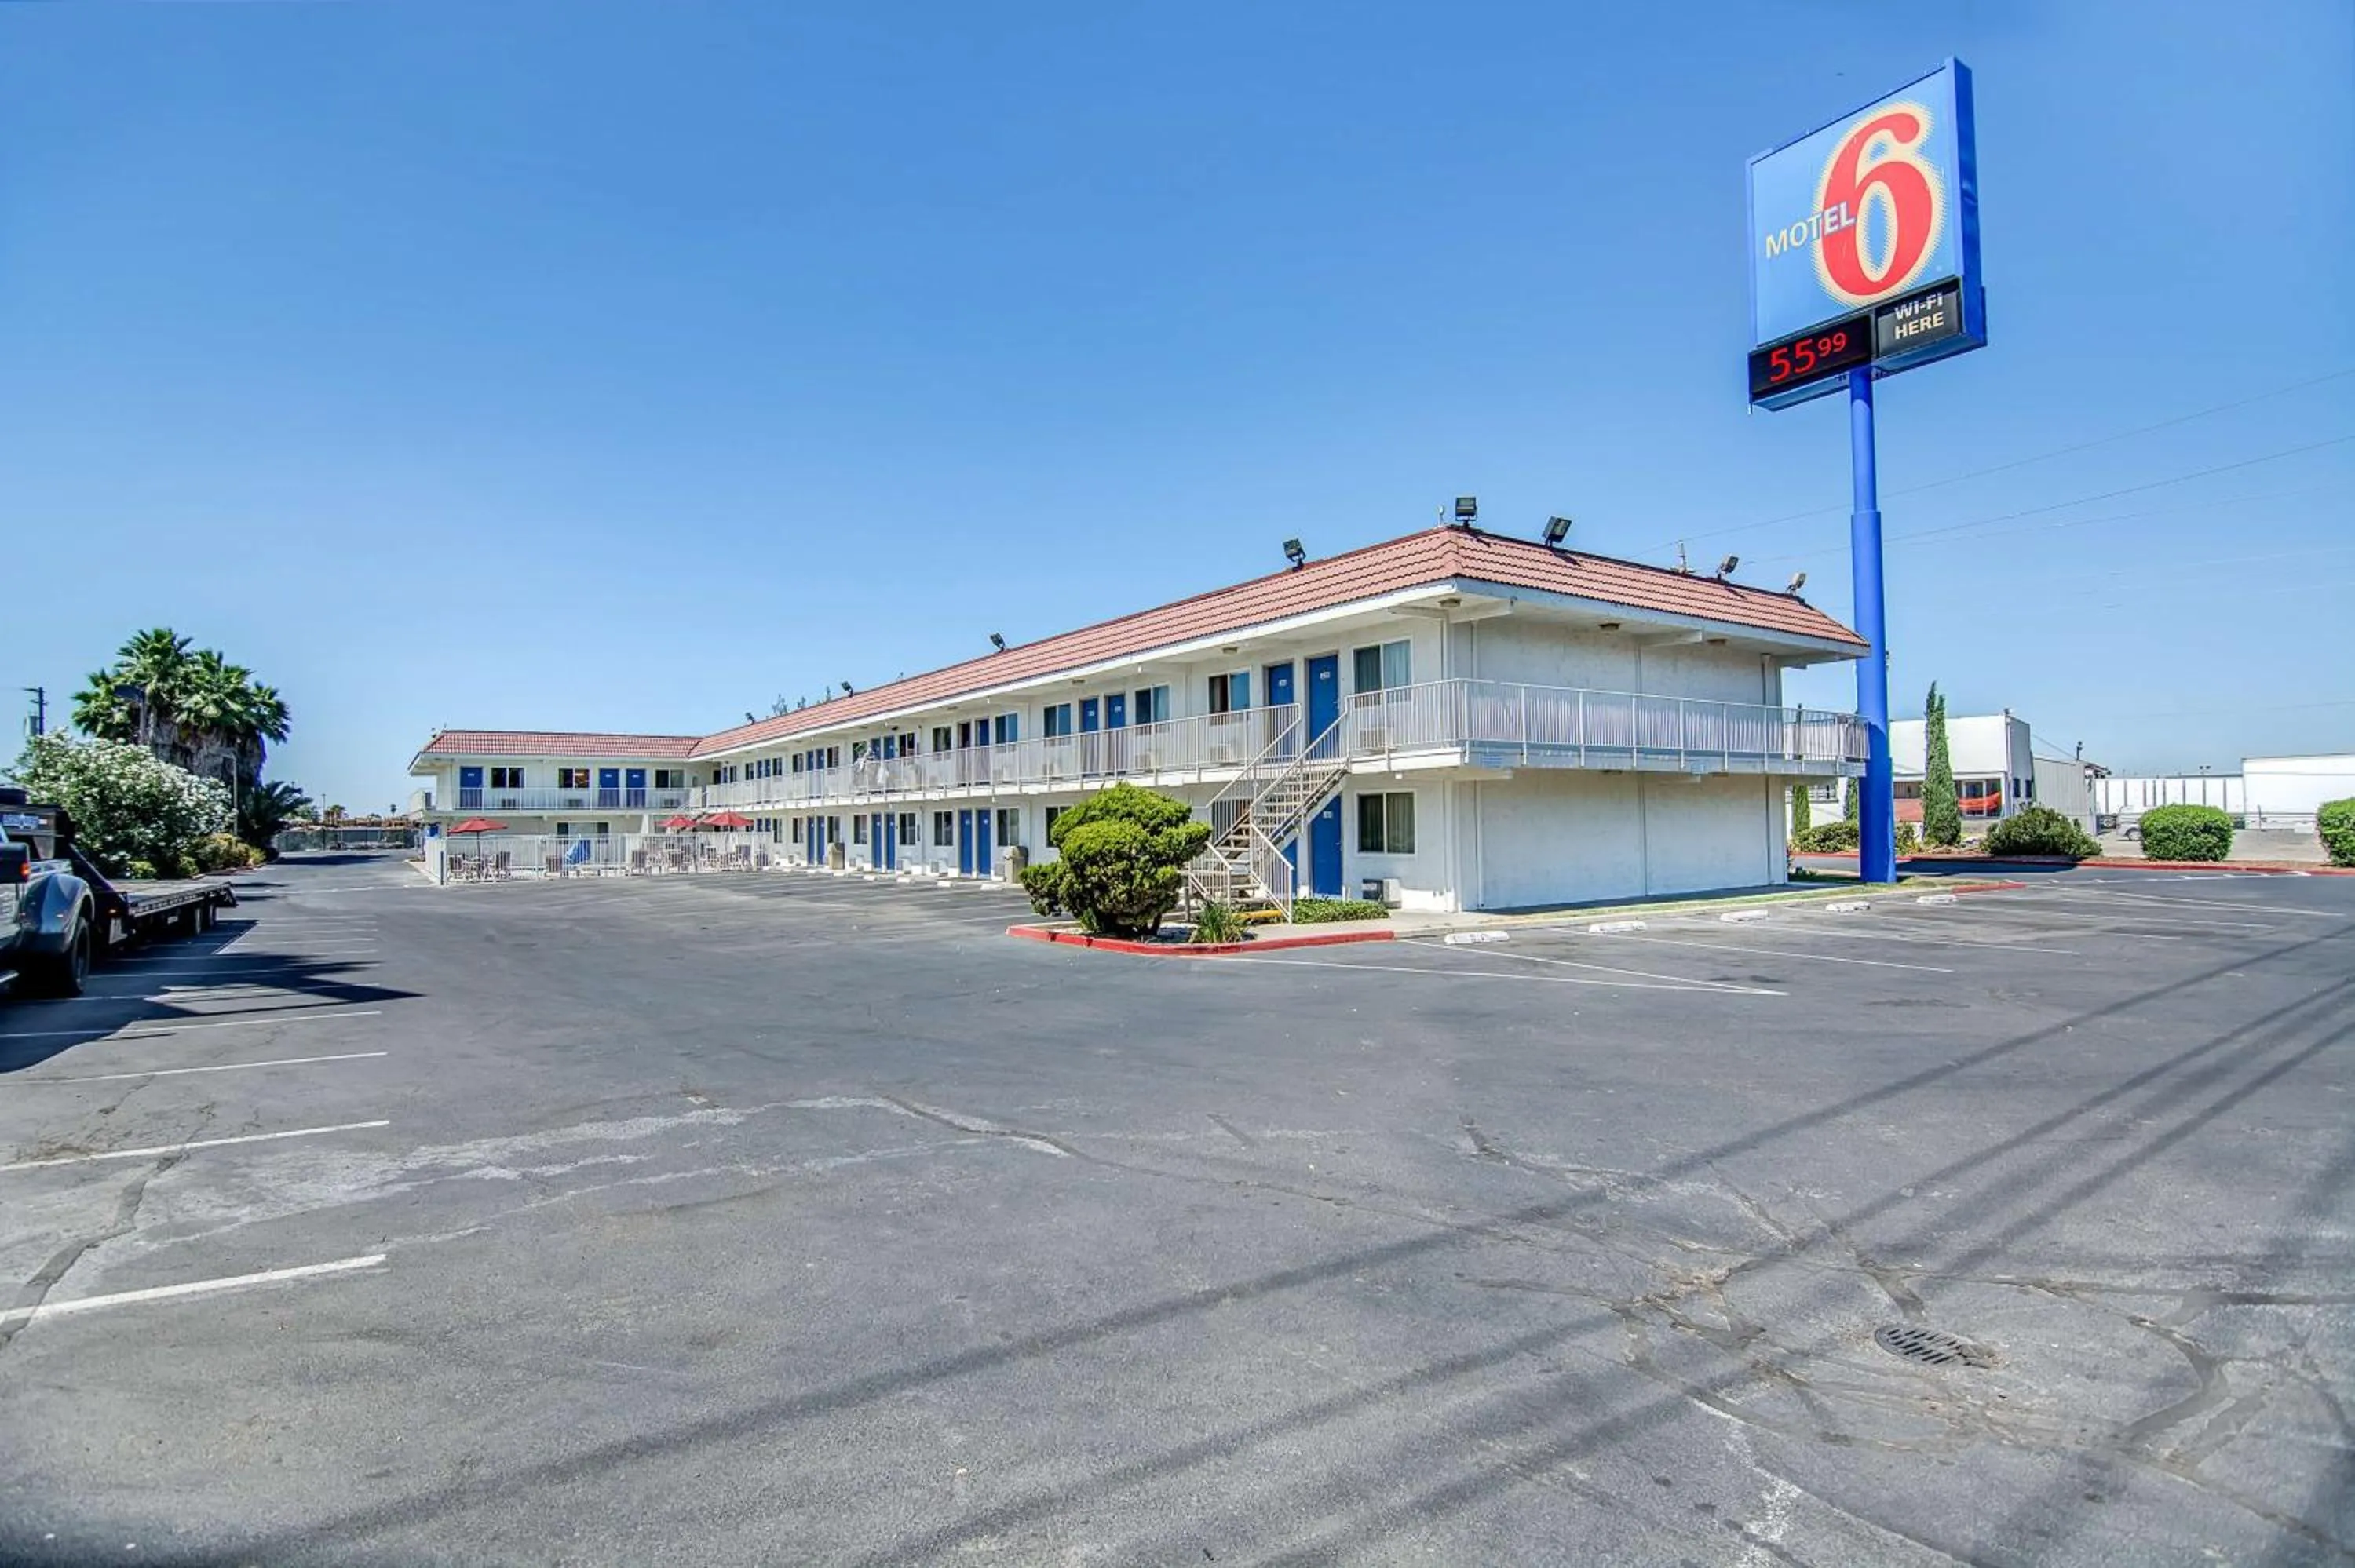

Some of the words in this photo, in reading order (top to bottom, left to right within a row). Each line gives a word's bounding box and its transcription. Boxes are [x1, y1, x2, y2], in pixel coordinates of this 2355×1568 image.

[1765, 201, 1856, 259] MOTEL
[1820, 111, 1933, 297] 6
[1893, 311, 1944, 340] HERE
